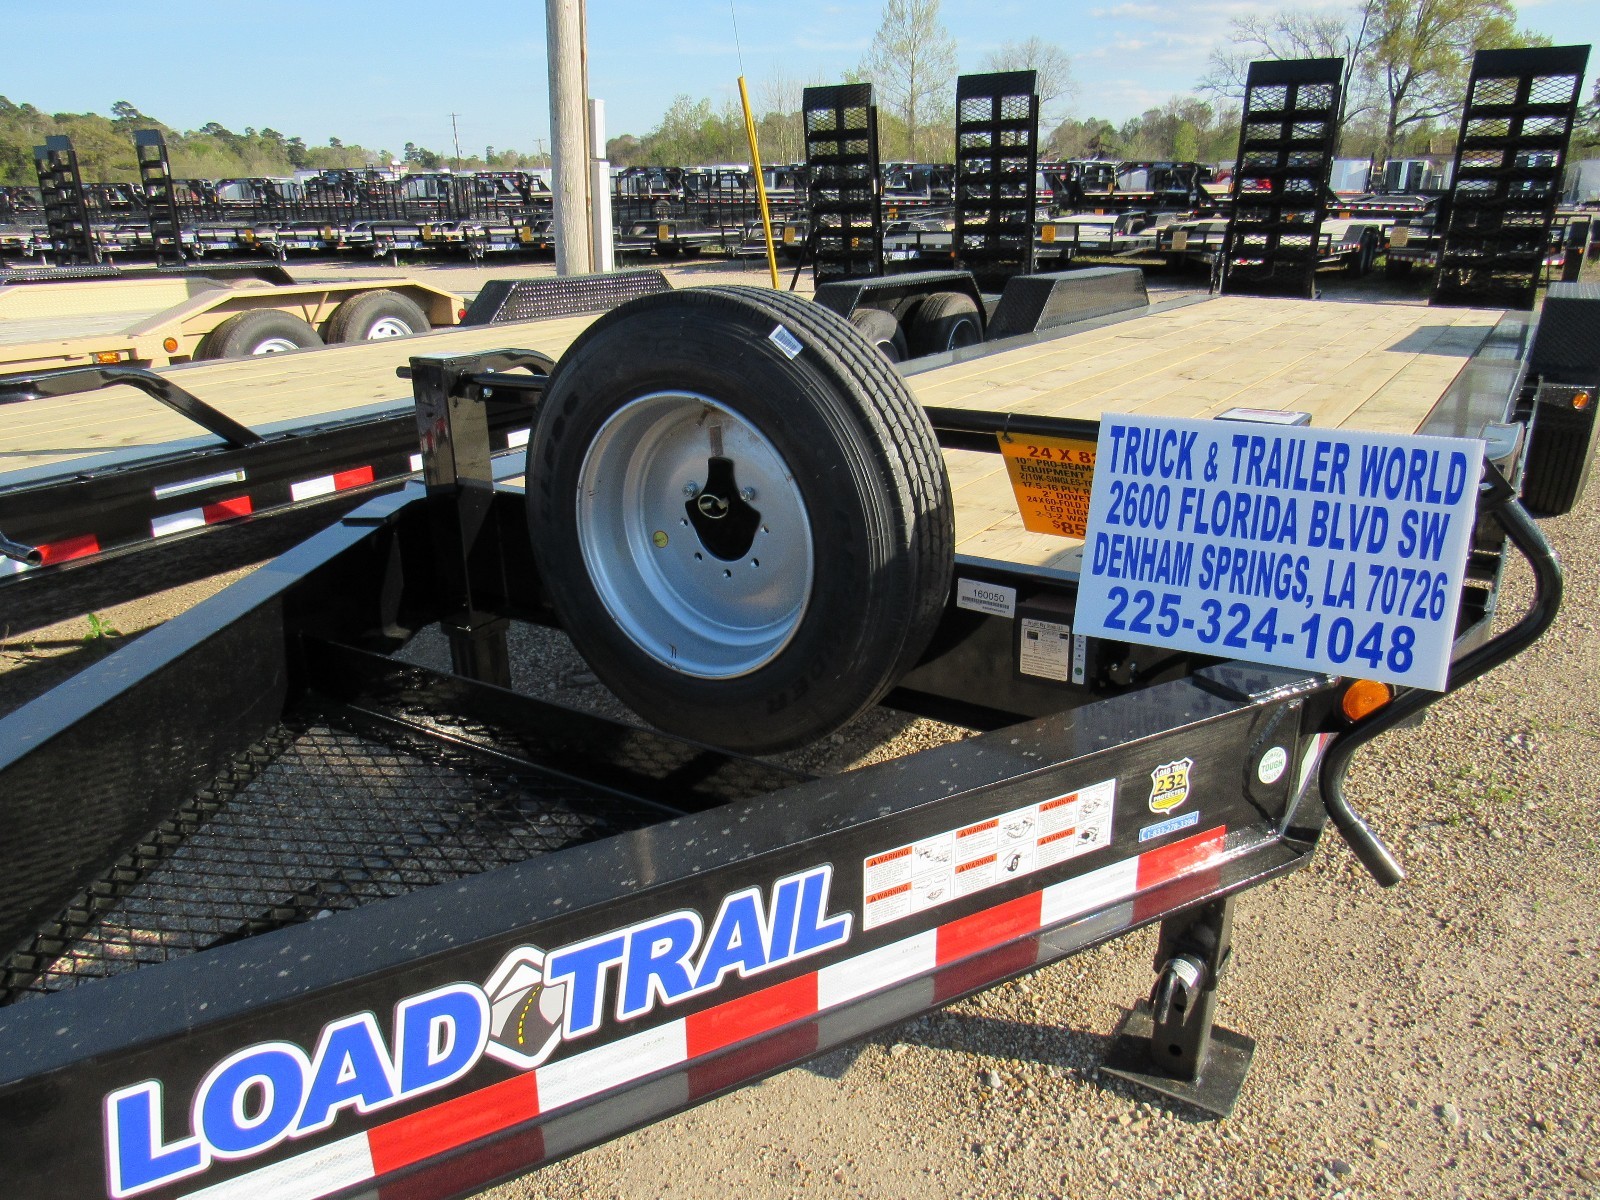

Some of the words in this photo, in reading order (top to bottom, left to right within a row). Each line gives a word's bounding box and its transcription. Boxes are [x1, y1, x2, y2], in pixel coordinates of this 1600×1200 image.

[1027, 446, 1052, 459] 24
[1059, 449, 1073, 462] X
[1020, 465, 1085, 478] EQUIPMENT
[1110, 425, 1198, 480] TRUCK
[1203, 442, 1218, 482] &
[1231, 434, 1351, 495] TRAILER
[1358, 445, 1467, 505] WORLD
[1061, 485, 1079, 494] PLY
[1044, 505, 1064, 513] LED
[1105, 481, 1170, 530] 2600
[1177, 487, 1297, 545] FLORIDA
[1308, 500, 1389, 554] BLVD
[1397, 509, 1450, 561] SW
[1091, 532, 1194, 588] DENHAM
[1199, 544, 1314, 609] SPRINGS,
[1322, 559, 1356, 609] LA
[1366, 564, 1448, 621] 70726
[973, 589, 1005, 603] 160050
[1103, 586, 1416, 674] 225-324-1048
[1156, 767, 1171, 778] LOAD
[1261, 759, 1283, 772] TOUGH
[1157, 774, 1184, 792] 232
[1048, 794, 1075, 809] WARNING
[966, 821, 996, 835] WARNING
[1047, 828, 1073, 844] WARNING
[877, 848, 909, 864] WARNING
[965, 855, 994, 870] WARNING
[877, 884, 908, 900] WARNING
[110, 984, 488, 1196] LOAD
[546, 867, 850, 1038] TRAIL
